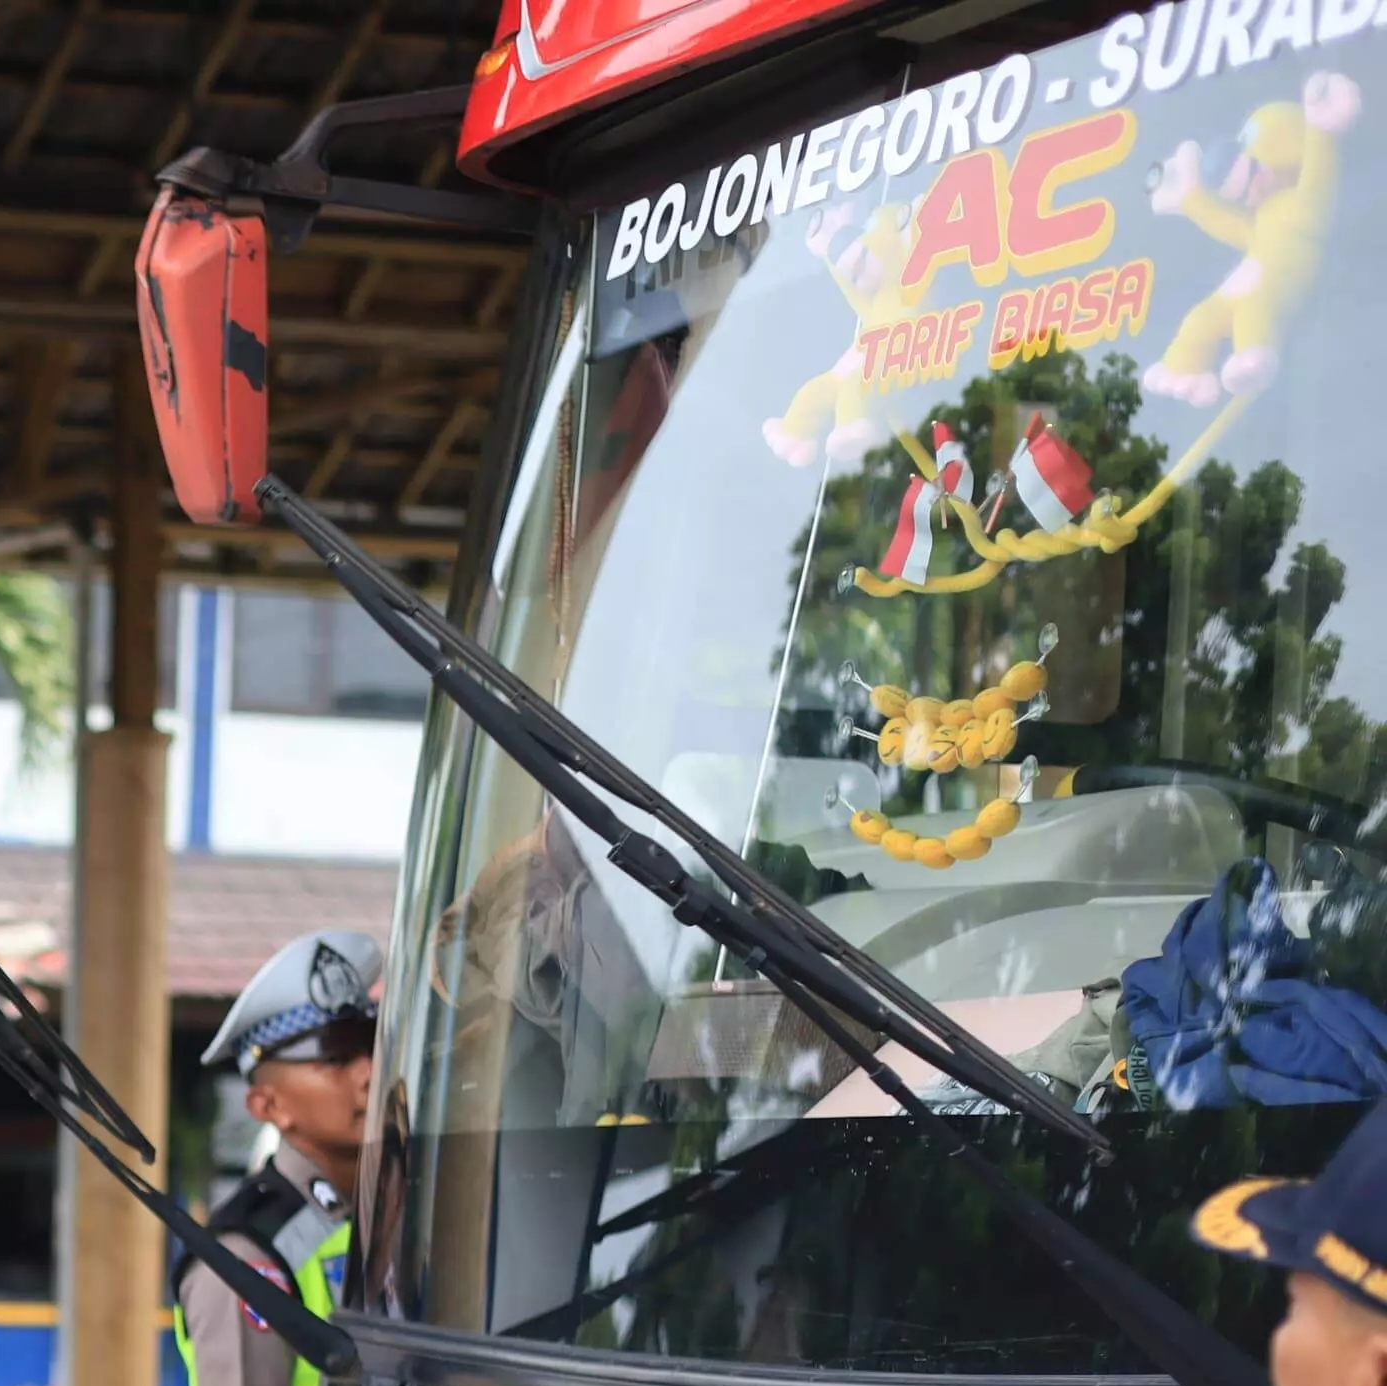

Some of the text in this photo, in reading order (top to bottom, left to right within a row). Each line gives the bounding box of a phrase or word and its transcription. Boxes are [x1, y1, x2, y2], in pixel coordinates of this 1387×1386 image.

[607, 53, 1031, 281] BOJONEGORO
[1090, 0, 1387, 108] SURA
[900, 110, 1132, 291] AC
[859, 260, 1151, 385] TARIF BIASA
